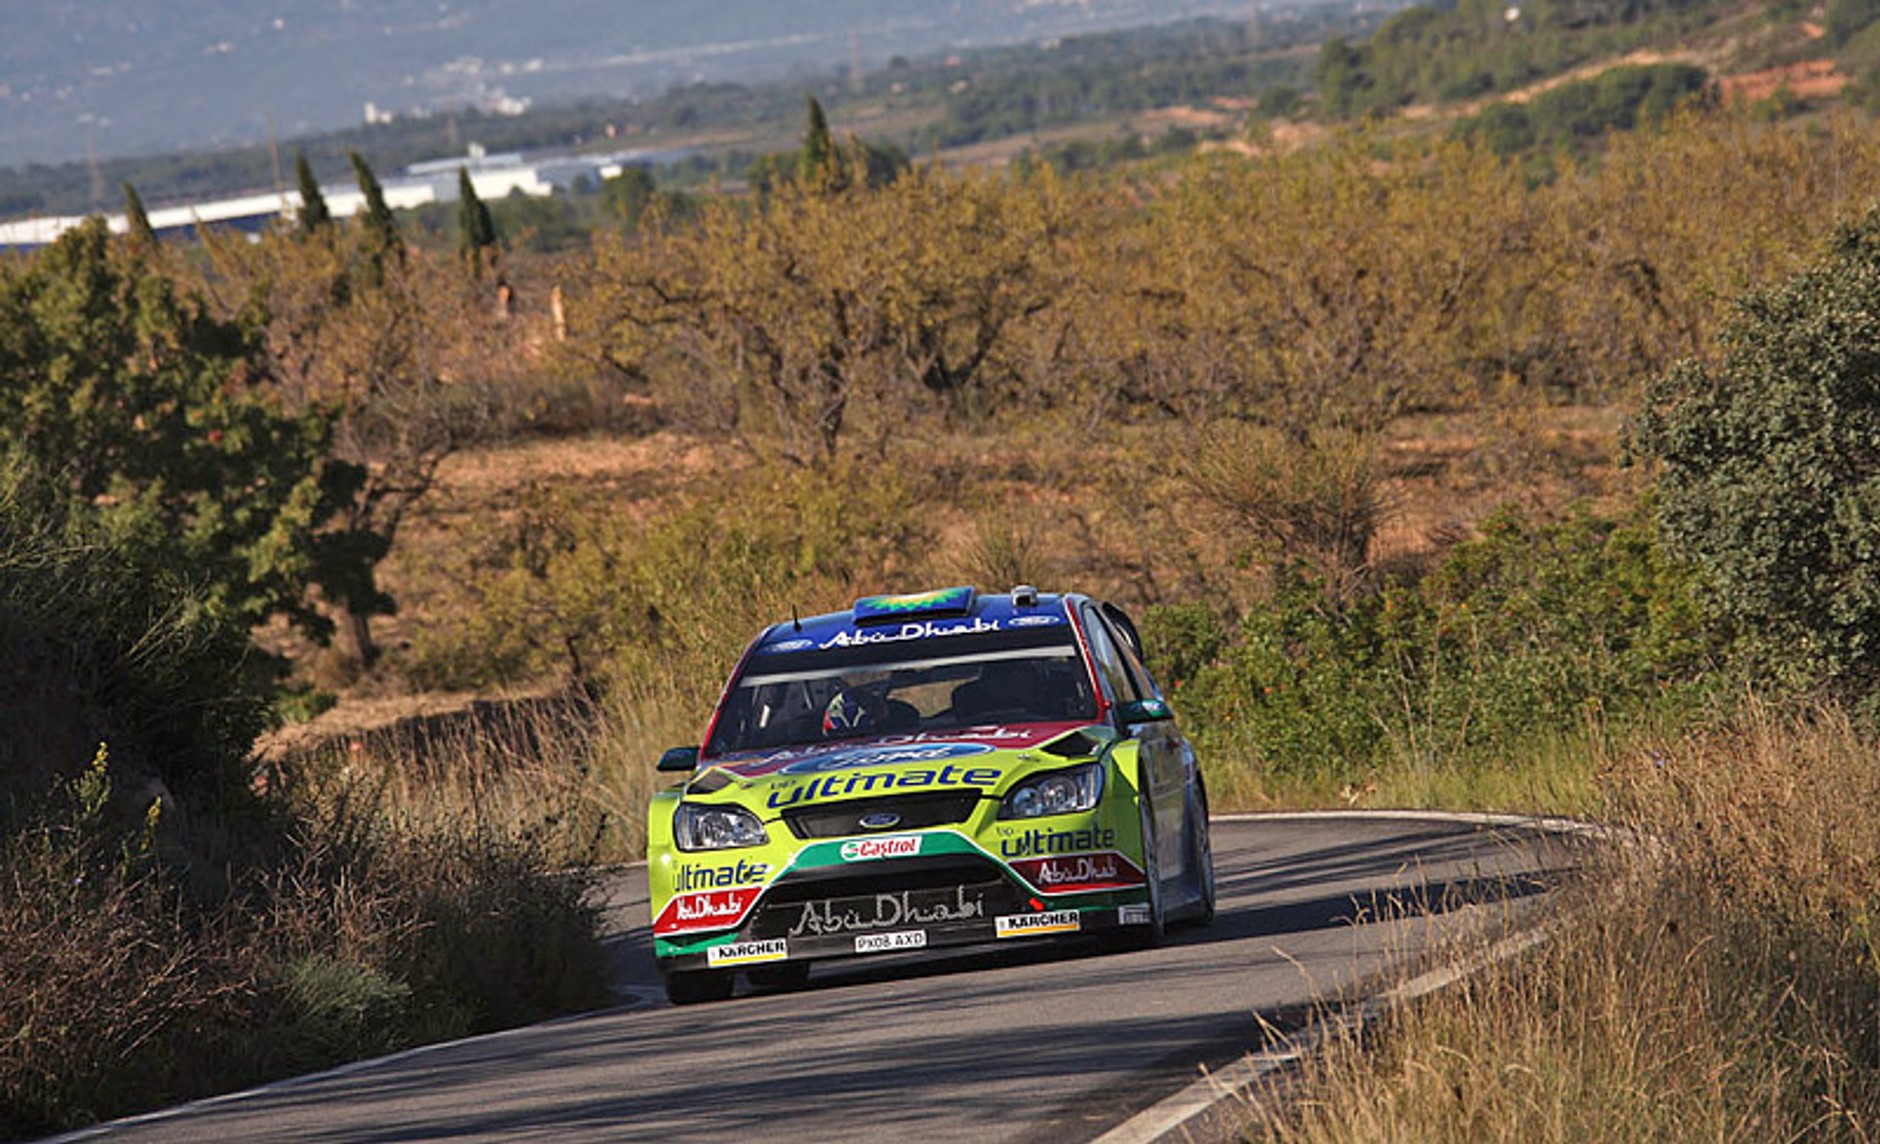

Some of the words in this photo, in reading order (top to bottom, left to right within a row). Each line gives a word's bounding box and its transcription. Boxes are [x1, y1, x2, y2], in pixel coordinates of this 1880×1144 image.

[766, 764, 1001, 809] ultimate
[860, 838, 916, 857] Castrol
[1001, 822, 1115, 857] ultimate
